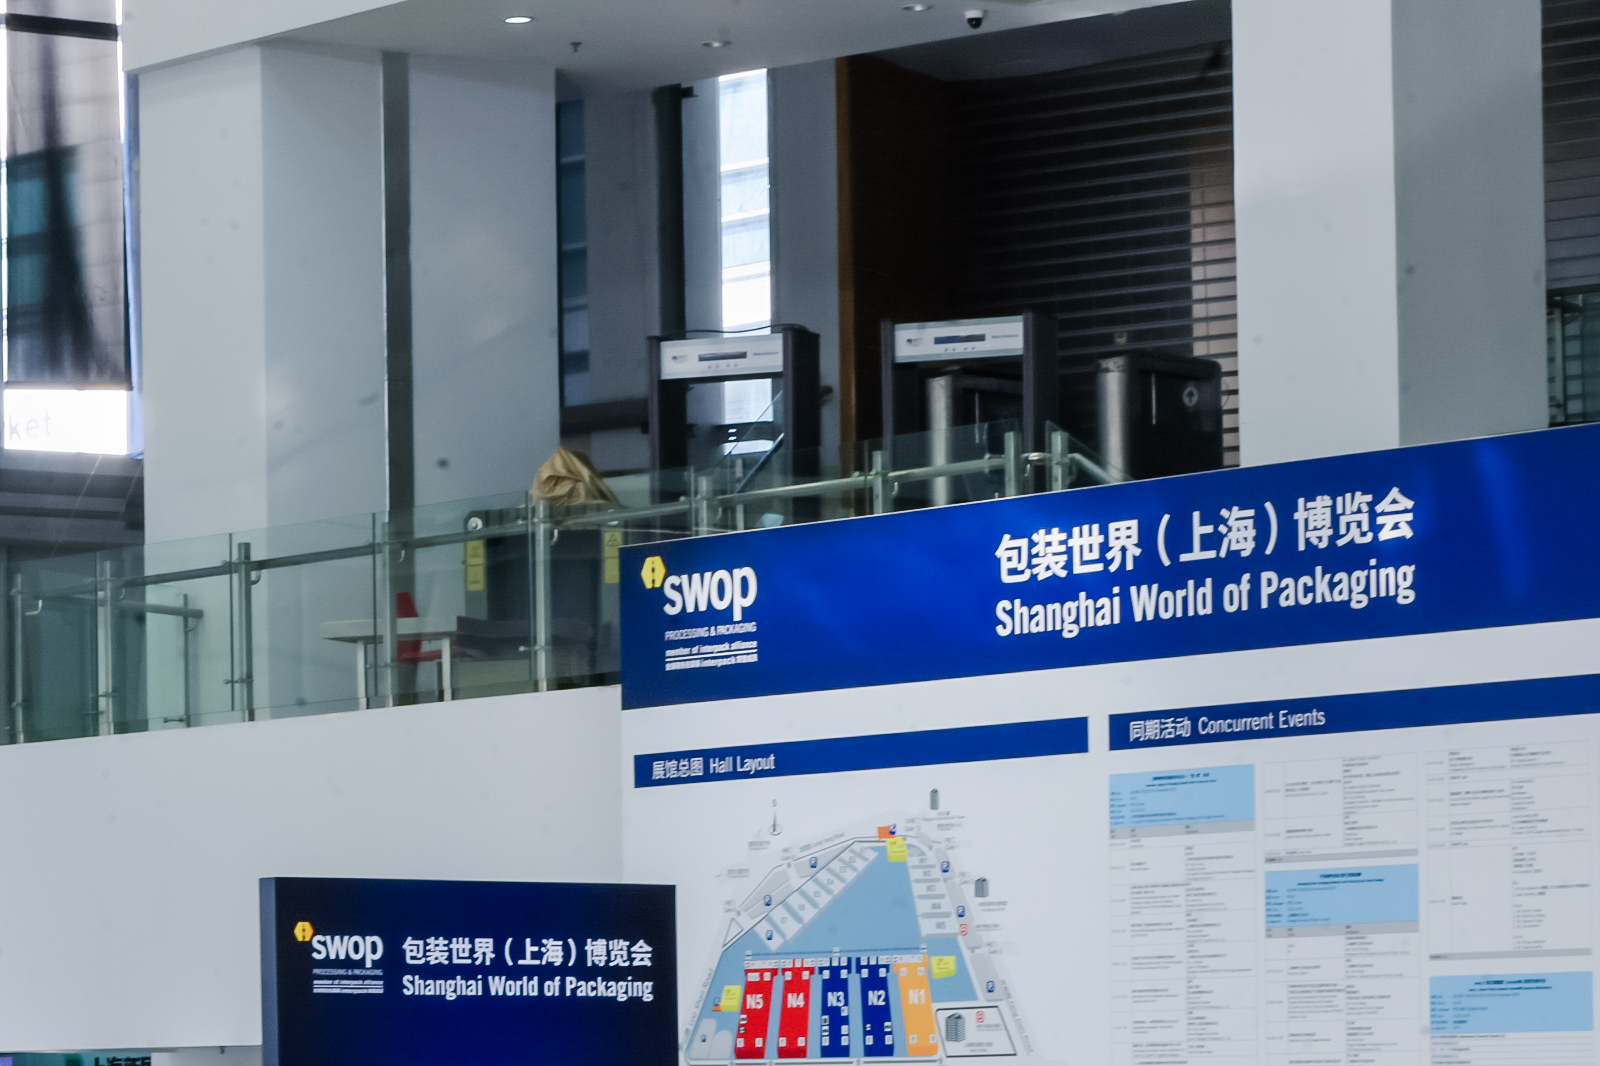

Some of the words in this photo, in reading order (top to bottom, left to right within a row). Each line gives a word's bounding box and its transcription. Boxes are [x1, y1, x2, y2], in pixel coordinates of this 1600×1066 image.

[994, 486, 1416, 584] 包装世界（上海）博览会
[663, 566, 758, 622] swop
[994, 588, 1120, 640] Shanghai
[1130, 577, 1213, 623] World
[1222, 573, 1252, 615] of
[1260, 558, 1416, 609] Packaging
[1129, 716, 1192, 742] 同期活动
[1198, 713, 1275, 736] Concurrent
[1278, 709, 1327, 730] Events
[652, 756, 704, 780] 展馆总图
[709, 756, 734, 774] Hall
[736, 754, 776, 775] Layout
[311, 935, 383, 968] swop
[401, 938, 654, 968] 包装世界（上海）博览会
[402, 975, 482, 1001] Shanghai
[488, 976, 539, 998] World
[543, 976, 561, 998] of
[565, 977, 654, 1002] Packaging
[746, 993, 763, 1010] N5
[786, 992, 805, 1009] N4
[827, 991, 845, 1008] N3
[868, 990, 886, 1006] N2
[908, 989, 927, 1005] N1
